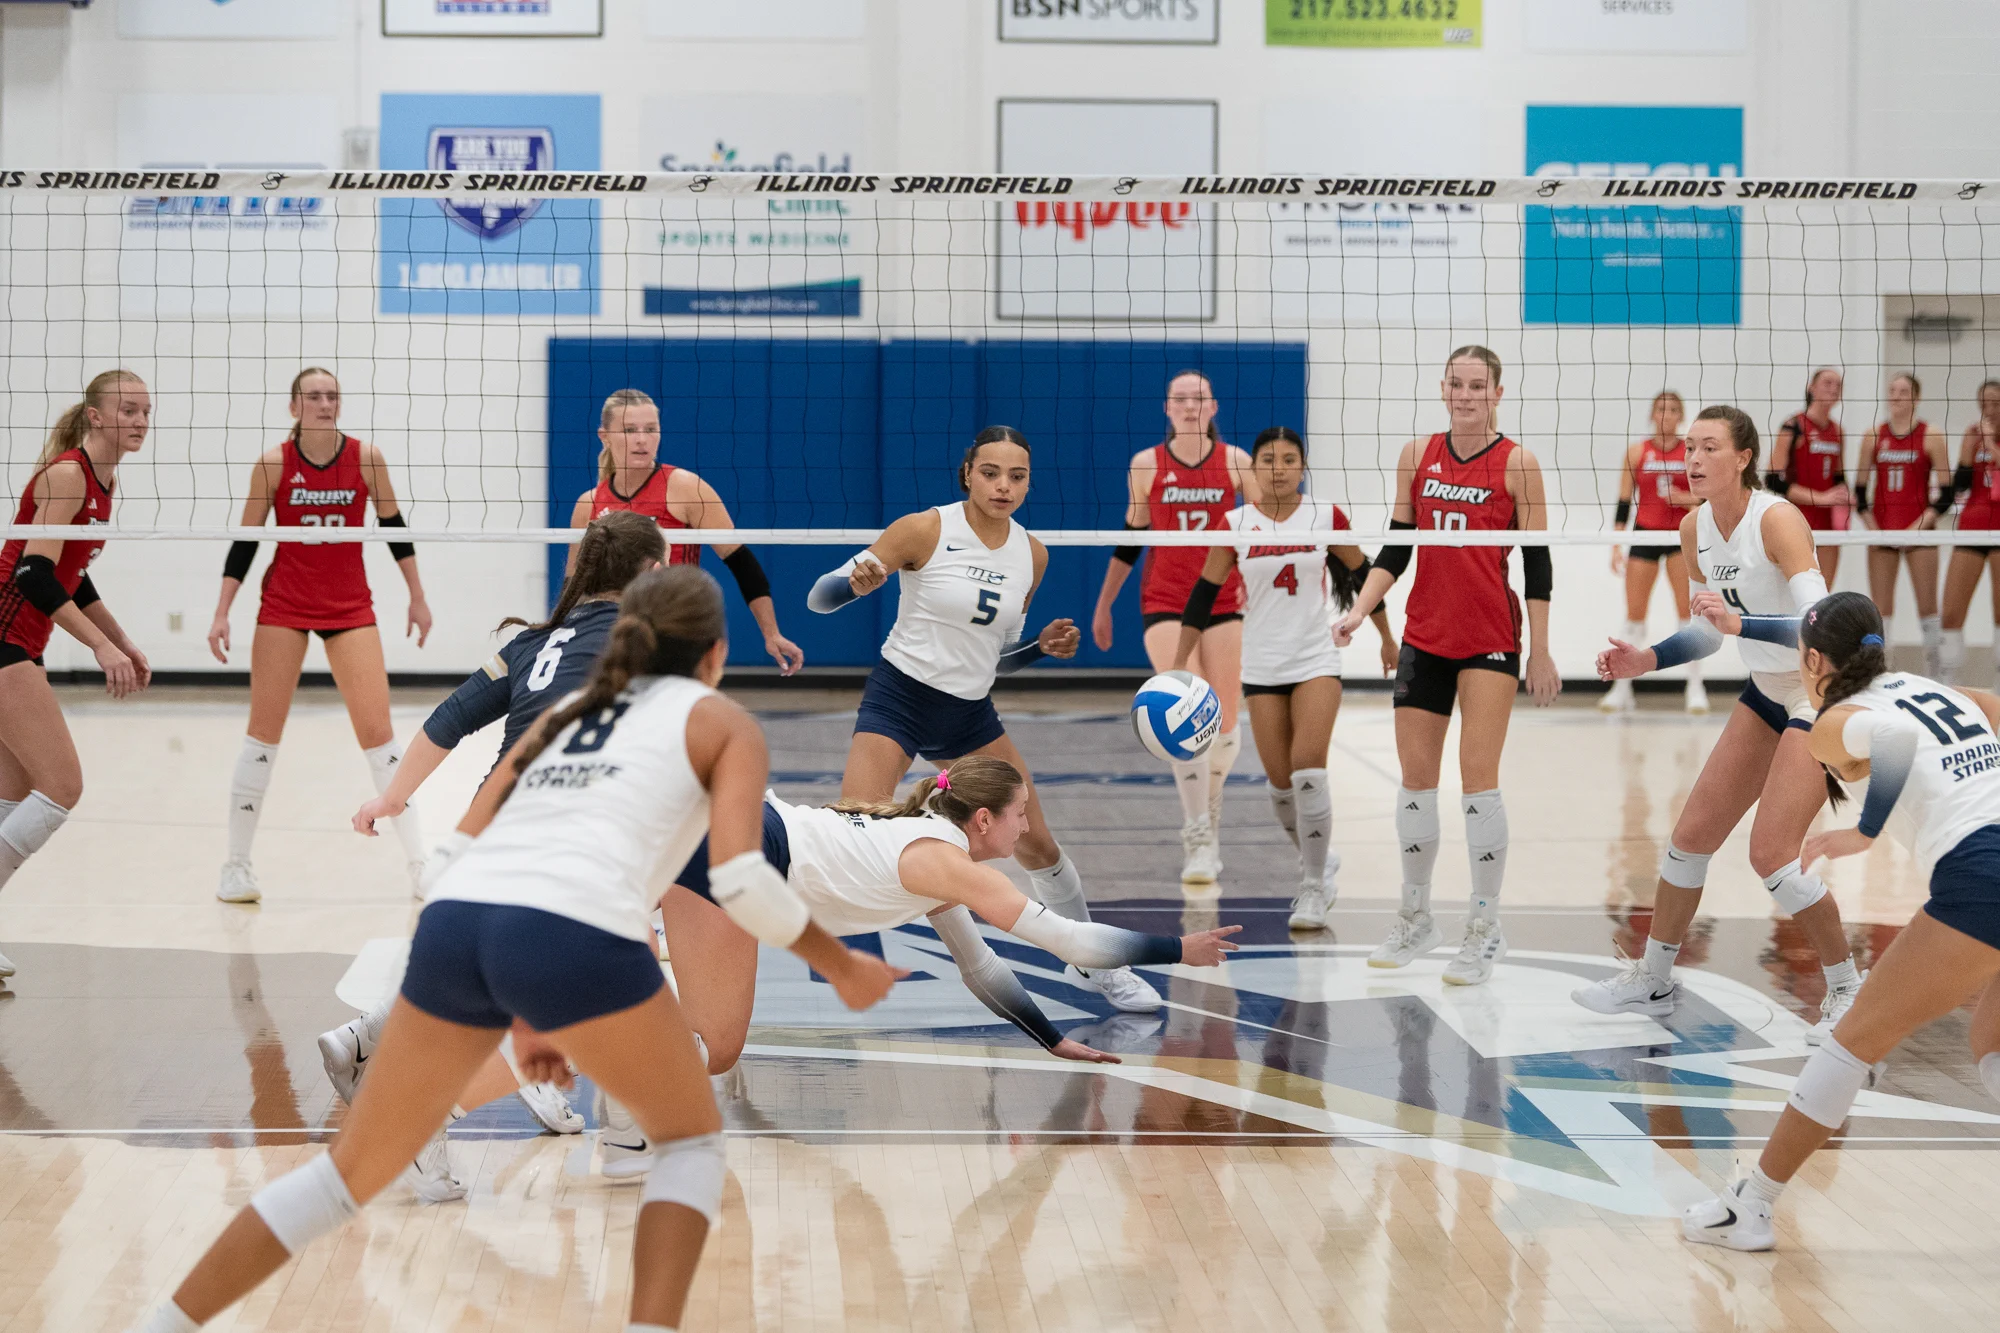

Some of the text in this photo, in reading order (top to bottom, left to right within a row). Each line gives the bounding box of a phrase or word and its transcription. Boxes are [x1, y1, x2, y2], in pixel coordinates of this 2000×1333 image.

[36, 171, 221, 190] SPRINGFIELD
[328, 172, 648, 192] ILLINOIS SPRINGFIELD
[754, 175, 1073, 195] ILLINOIS SPRINGFIELD
[1179, 177, 1497, 197] ILLINOIS SPRINGFIELD
[1602, 179, 1918, 199] ILLINOIS SPRINGFIELD
[288, 487, 357, 506] DRURY
[1160, 486, 1225, 504] DRURY
[1421, 477, 1494, 505] DRURY
[966, 565, 1009, 586] UIS
[1273, 563, 1299, 597] 4
[1712, 564, 1741, 581] UIS
[970, 587, 1002, 626] 5
[526, 627, 577, 692] 6
[1895, 692, 1988, 746] 12
